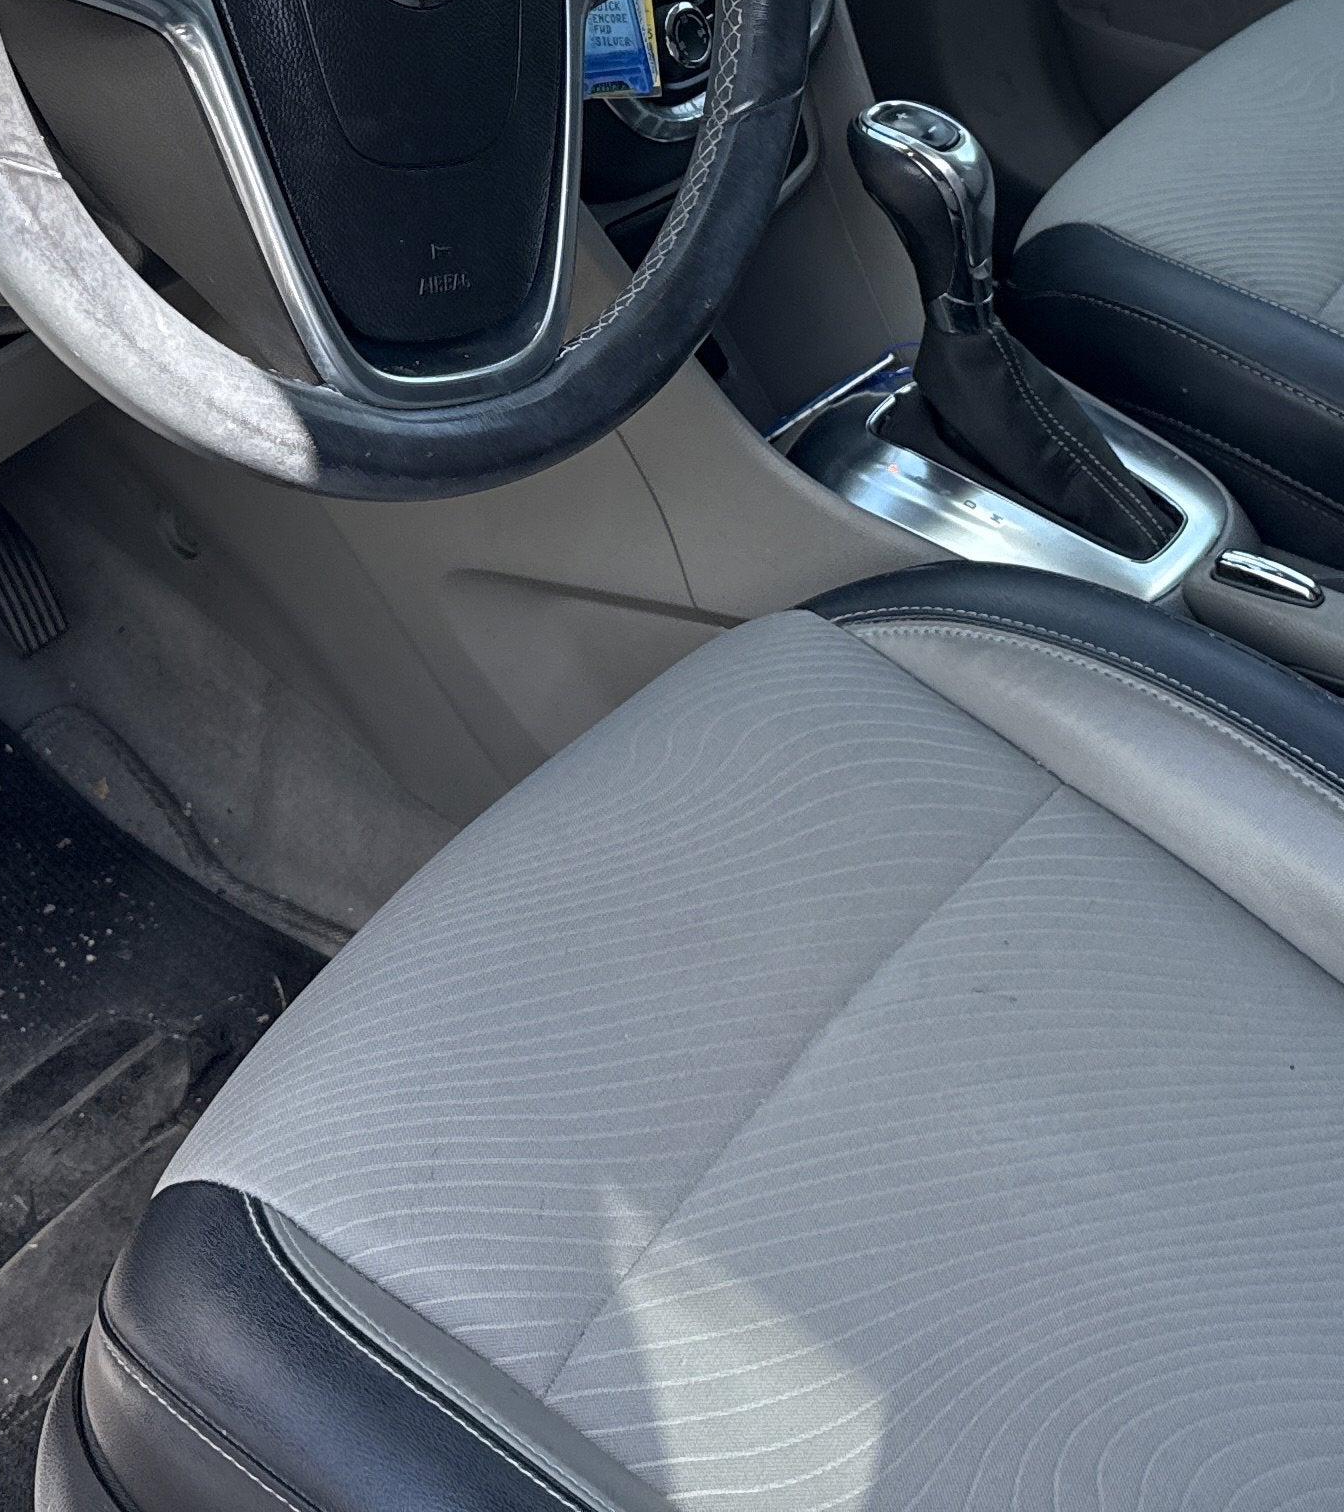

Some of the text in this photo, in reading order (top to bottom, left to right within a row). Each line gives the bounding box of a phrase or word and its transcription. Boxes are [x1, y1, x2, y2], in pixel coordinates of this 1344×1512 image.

[593, 0, 621, 12] UICK
[592, 13, 628, 24] ENCORE
[593, 24, 612, 35] FWD
[596, 36, 632, 47] SILVER
